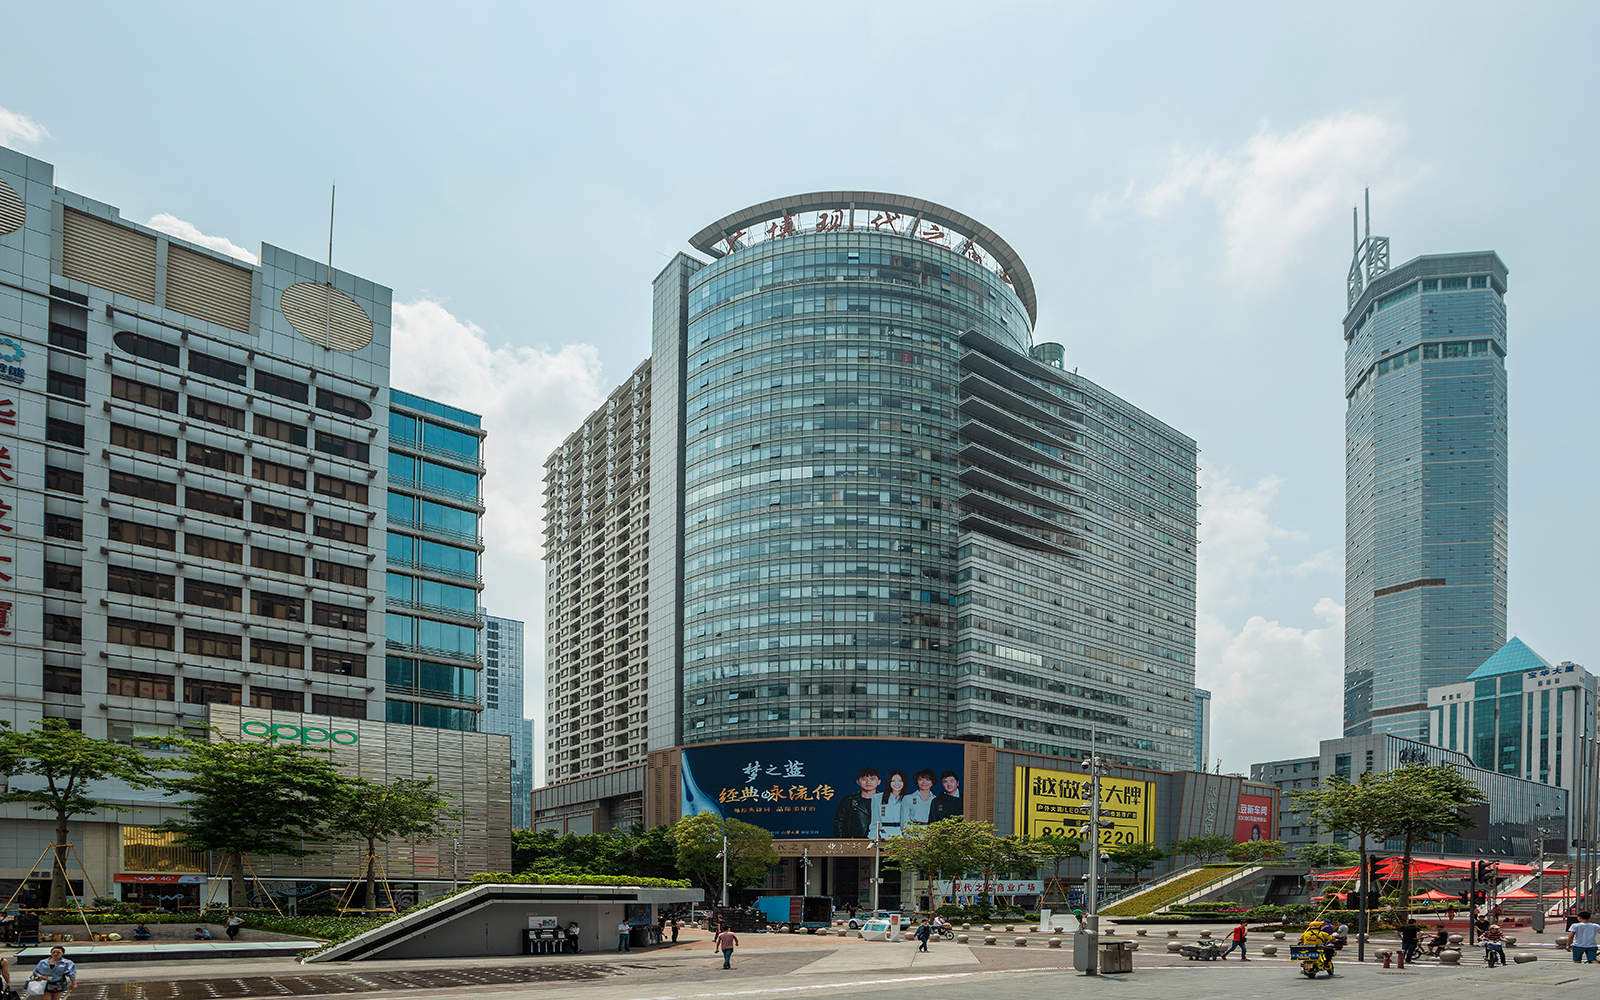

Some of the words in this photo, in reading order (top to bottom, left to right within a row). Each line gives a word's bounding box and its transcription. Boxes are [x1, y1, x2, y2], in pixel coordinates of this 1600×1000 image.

[725, 209, 1012, 285] 广博现代之窗
[1527, 665, 1575, 679] 宝华大厦
[742, 759, 806, 784] 梦之蓝
[718, 784, 835, 804] 经典咏流传
[1204, 785, 1218, 836] 现代之窗
[1238, 803, 1268, 816] 豆新车网
